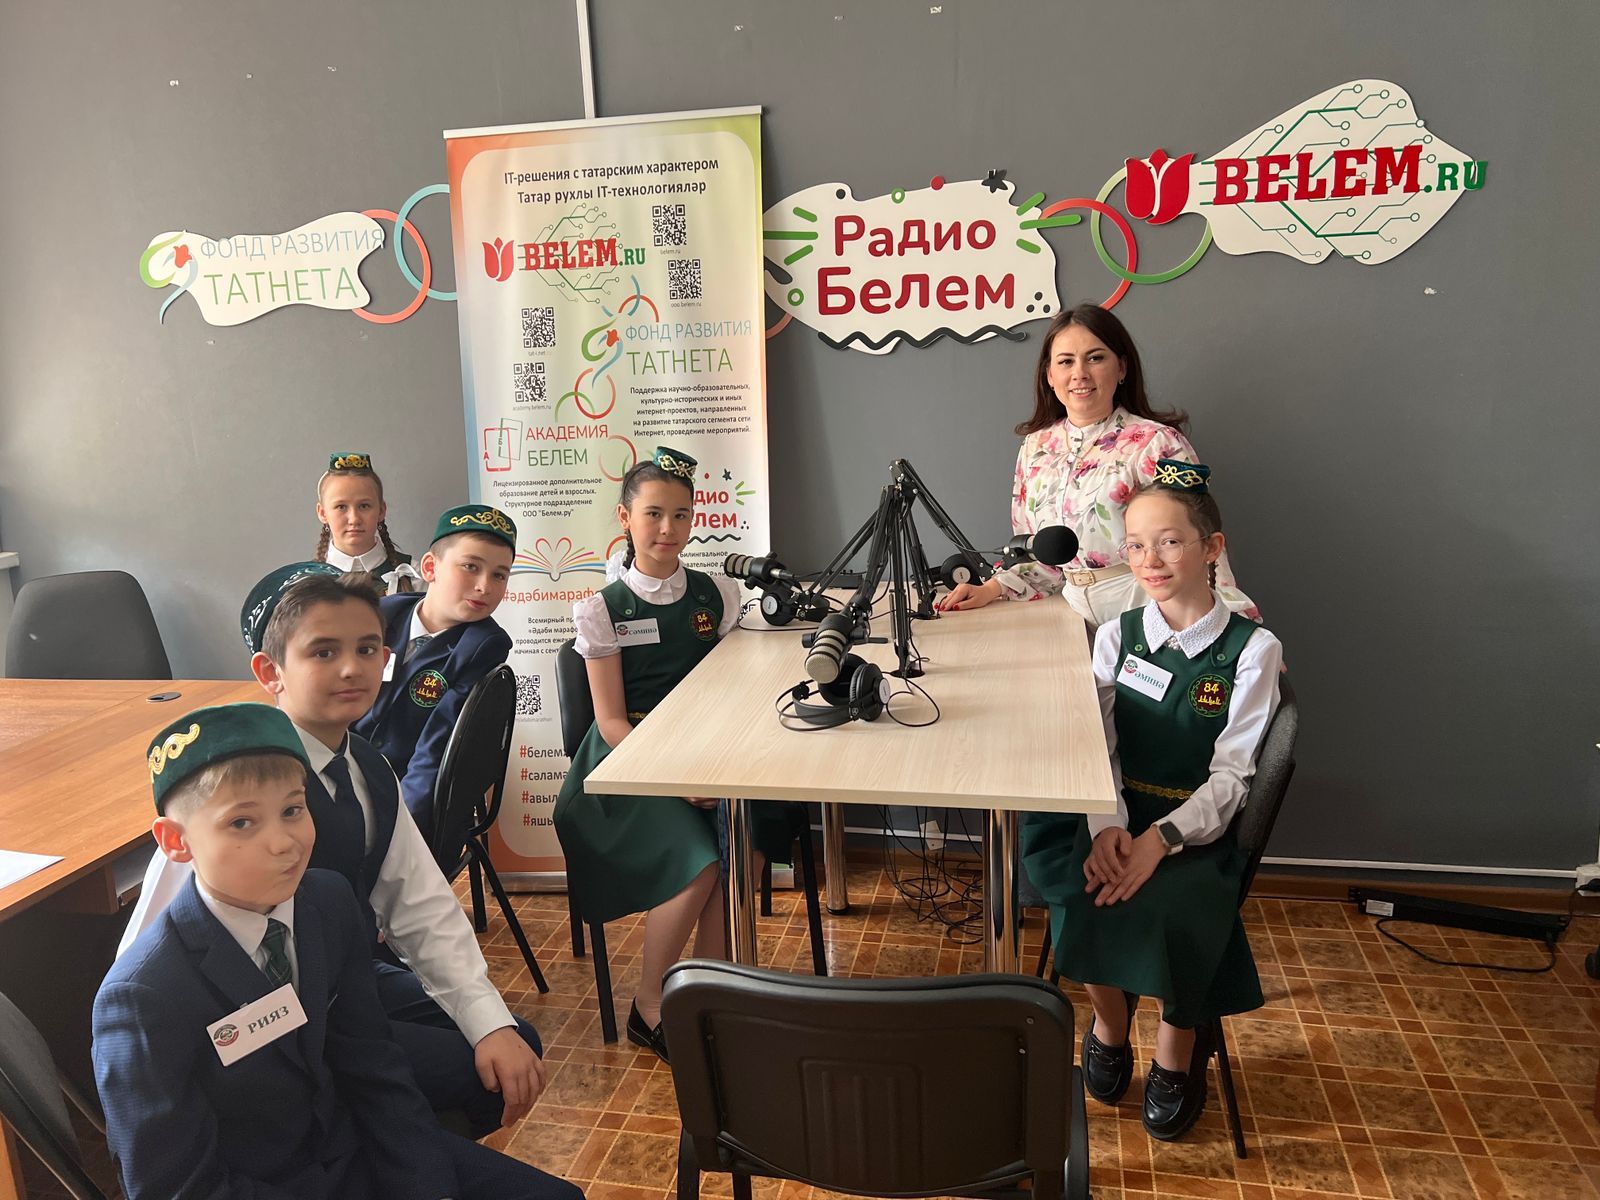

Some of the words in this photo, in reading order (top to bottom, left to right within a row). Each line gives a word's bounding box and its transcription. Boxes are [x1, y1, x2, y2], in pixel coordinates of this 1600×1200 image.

[504, 170, 570, 185] IT-решения
[573, 170, 579, 179] с
[581, 165, 643, 179] татарским
[646, 159, 719, 175] характером
[1213, 145, 1488, 205] BELEM.RU
[517, 191, 551, 204] Татар
[555, 187, 593, 204] рухлы
[597, 180, 707, 199] IT-технологияләр
[834, 214, 996, 257] Радио
[200, 236, 266, 261] ФОНД
[271, 228, 385, 256] РАЗВИТИЯ
[523, 238, 646, 271] BELEM.RU
[203, 266, 358, 305] ТАТНЕТА
[817, 266, 1015, 315] Белем
[625, 324, 672, 343] ФОНД
[675, 319, 752, 339] РАЗВИТИЯ
[626, 347, 733, 375] ТАТНЕТА
[630, 386, 667, 395] Поддержка
[668, 384, 751, 394] научно-образовательных,
[640, 396, 719, 405] культурно-исторических
[636, 407, 699, 416] интернет-проектов,
[700, 405, 746, 414] направленных
[642, 419, 671, 427] развитие
[672, 418, 706, 426] татарского
[526, 424, 609, 442] АКАДЕМИЯ
[666, 429, 705, 437] проведение
[706, 426, 751, 435] мероприятий.
[527, 448, 588, 466] БЕЛЕМ
[493, 480, 549, 488] Лицензированное
[549, 478, 603, 486] дополнительное
[499, 490, 538, 498] образование
[539, 488, 558, 497] детей
[504, 500, 542, 508] Структурное
[543, 499, 593, 507] подразделение
[693, 512, 737, 529] лем
[528, 616, 565, 625] Всемирный
[515, 637, 551, 646] проводится
[423, 677, 437, 688] 84
[1203, 682, 1219, 694] 84
[520, 744, 566, 758] #белем
[247, 1005, 289, 1034] РИЯЗ
